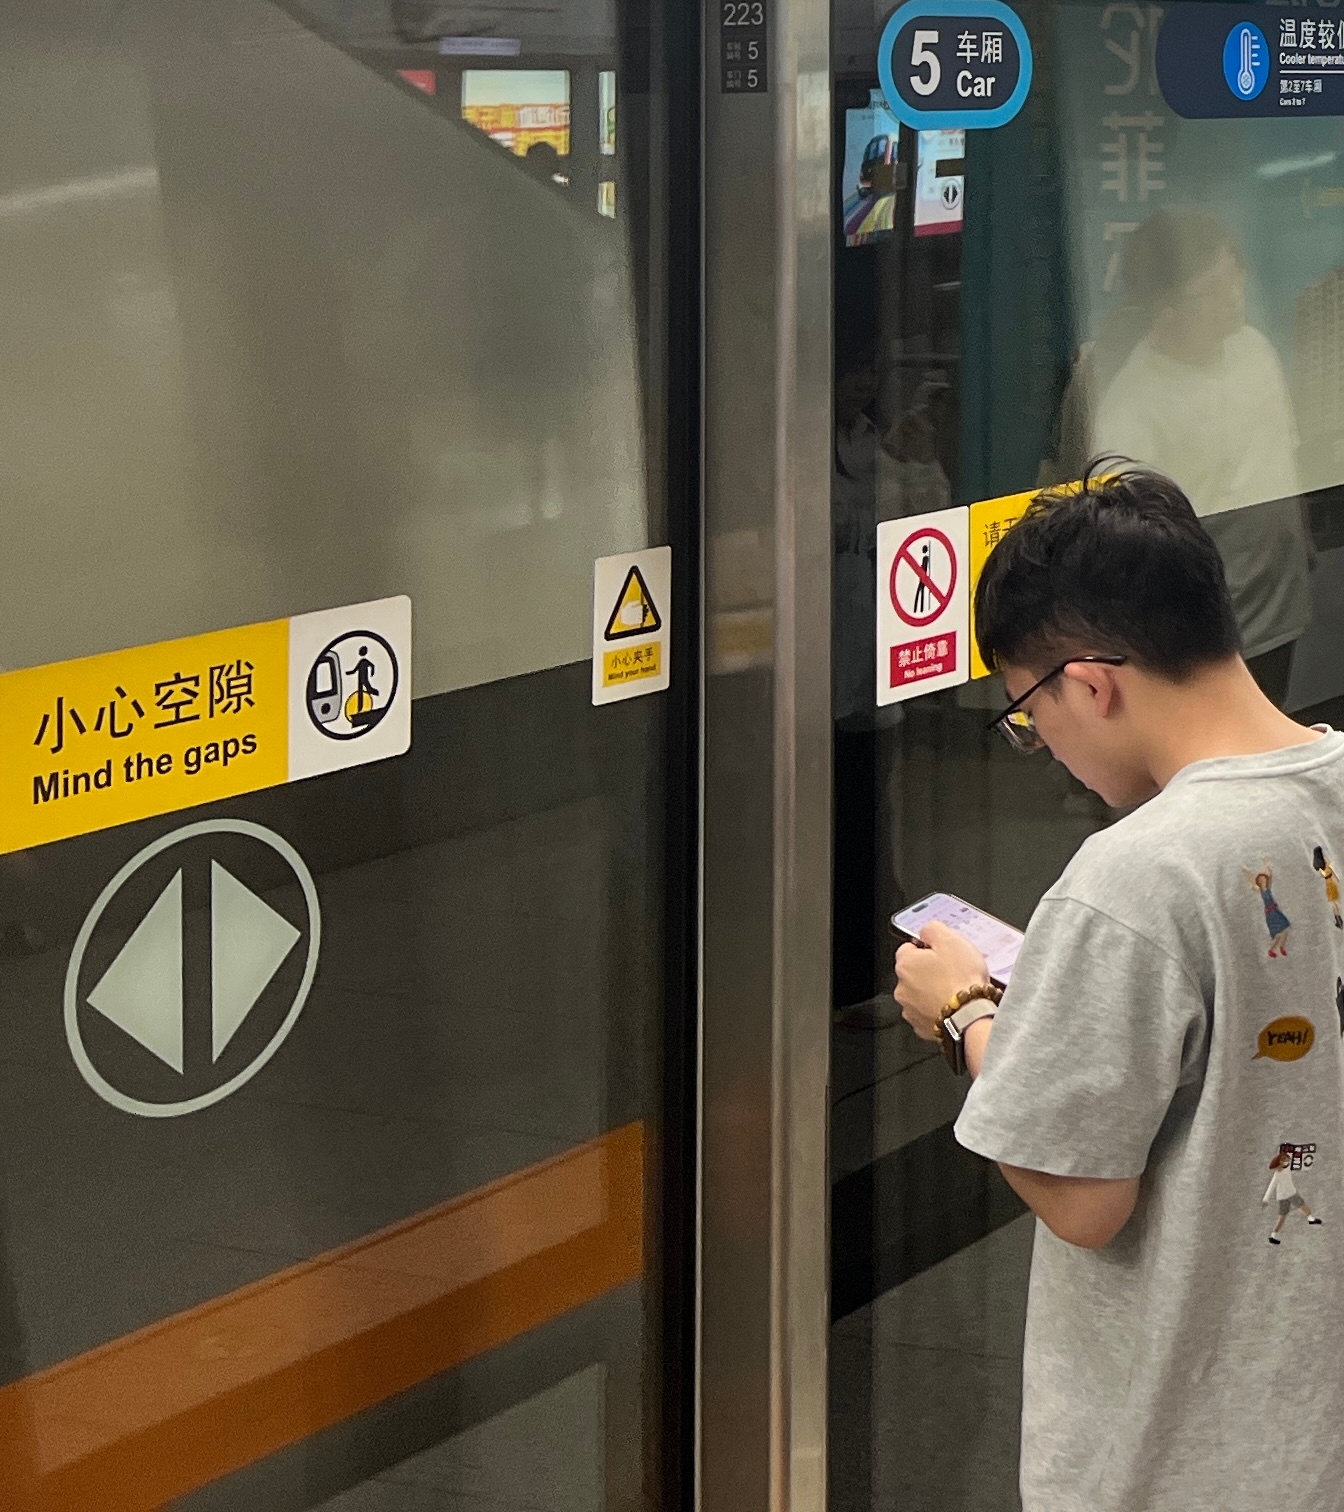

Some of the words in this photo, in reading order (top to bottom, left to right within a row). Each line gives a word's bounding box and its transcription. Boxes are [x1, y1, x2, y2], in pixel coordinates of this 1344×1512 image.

[723, 2, 764, 26] 223
[748, 41, 759, 60] 5
[1279, 52, 1307, 65] Cooler
[910, 30, 941, 96] 5
[956, 30, 1003, 64] 车厢
[747, 69, 758, 88] 5
[956, 70, 996, 97] Car
[611, 646, 654, 669] 小心夹手
[904, 668, 916, 679] No
[916, 662, 943, 677] leaning
[33, 658, 257, 755] 小心空隙
[32, 760, 113, 805] Mind
[123, 745, 173, 785] the
[184, 730, 258, 775] gaps
